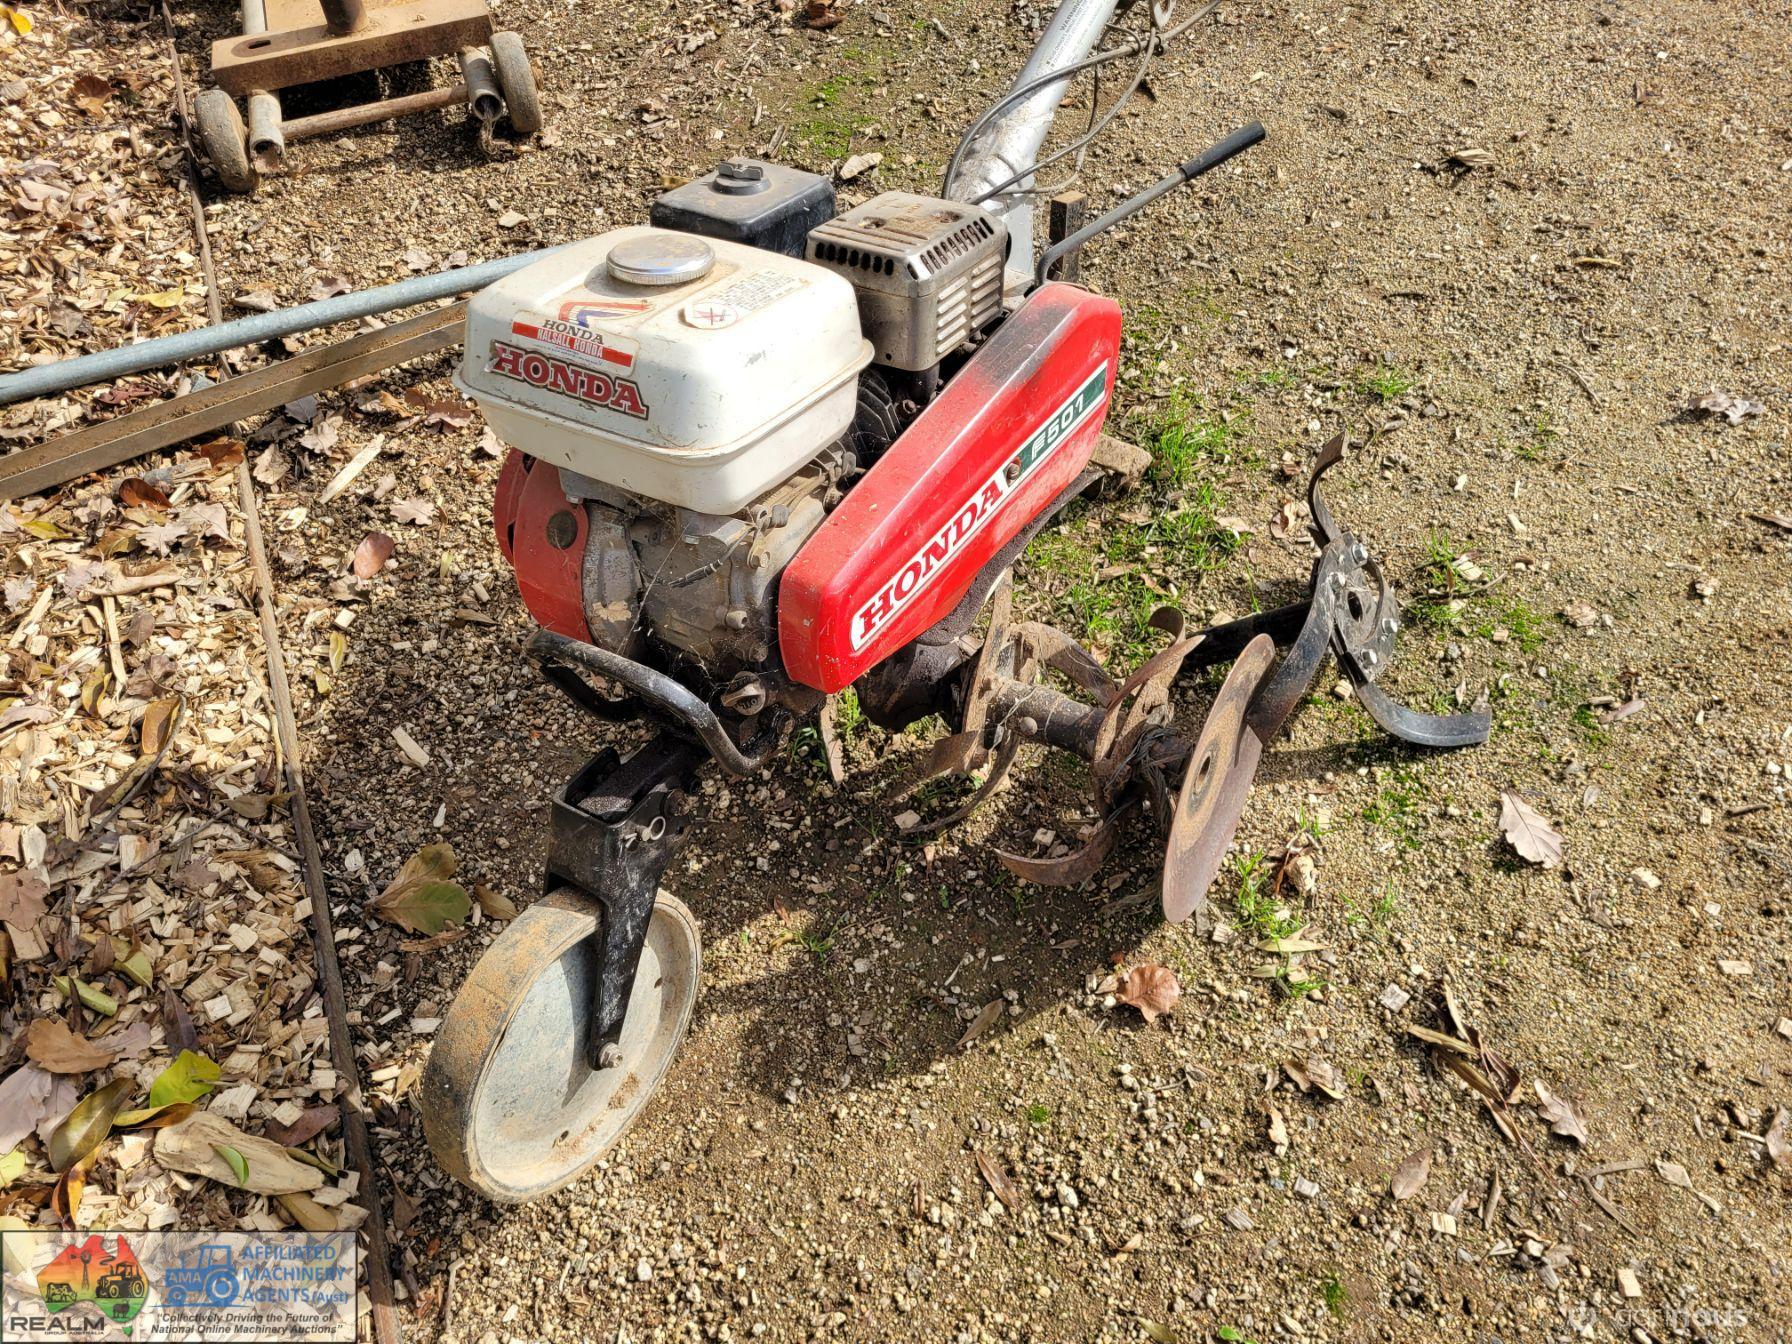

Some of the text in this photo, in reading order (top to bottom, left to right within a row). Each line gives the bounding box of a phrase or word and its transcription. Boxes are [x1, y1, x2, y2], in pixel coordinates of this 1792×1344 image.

[537, 328, 571, 348] HALSALL
[573, 338, 604, 358] HONDA
[543, 319, 604, 345] HONDA
[491, 342, 648, 418] HONDA
[858, 391, 1086, 639] HONDA F501
